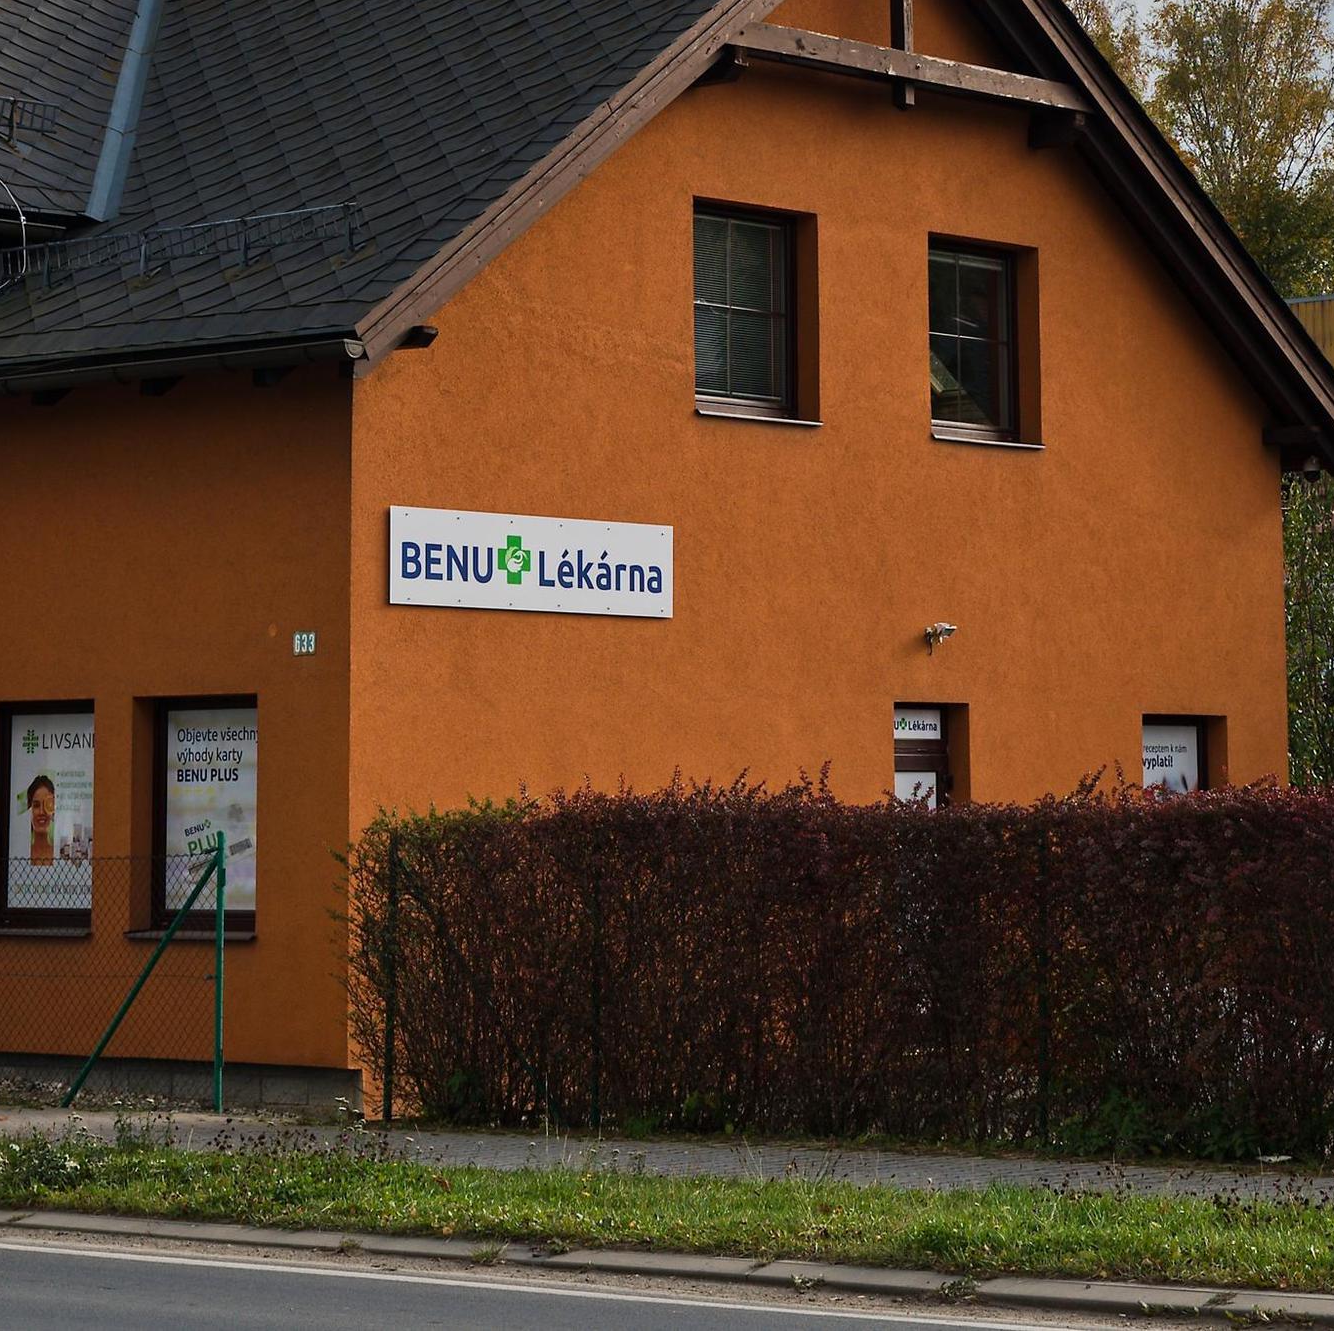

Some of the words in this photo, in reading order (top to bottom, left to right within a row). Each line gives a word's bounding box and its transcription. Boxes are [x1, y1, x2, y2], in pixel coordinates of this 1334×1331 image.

[400, 540, 493, 584] BENU
[538, 548, 663, 594] Lékárna
[294, 633, 315, 653] 633
[908, 720, 938, 732] Lékárna
[177, 727, 219, 745] Objevte
[220, 726, 259, 744] všechn
[177, 747, 214, 765] výhody
[216, 747, 243, 765] karty
[177, 768, 208, 783] BENU
[210, 768, 240, 783] PLUS
[184, 823, 205, 837] BENU
